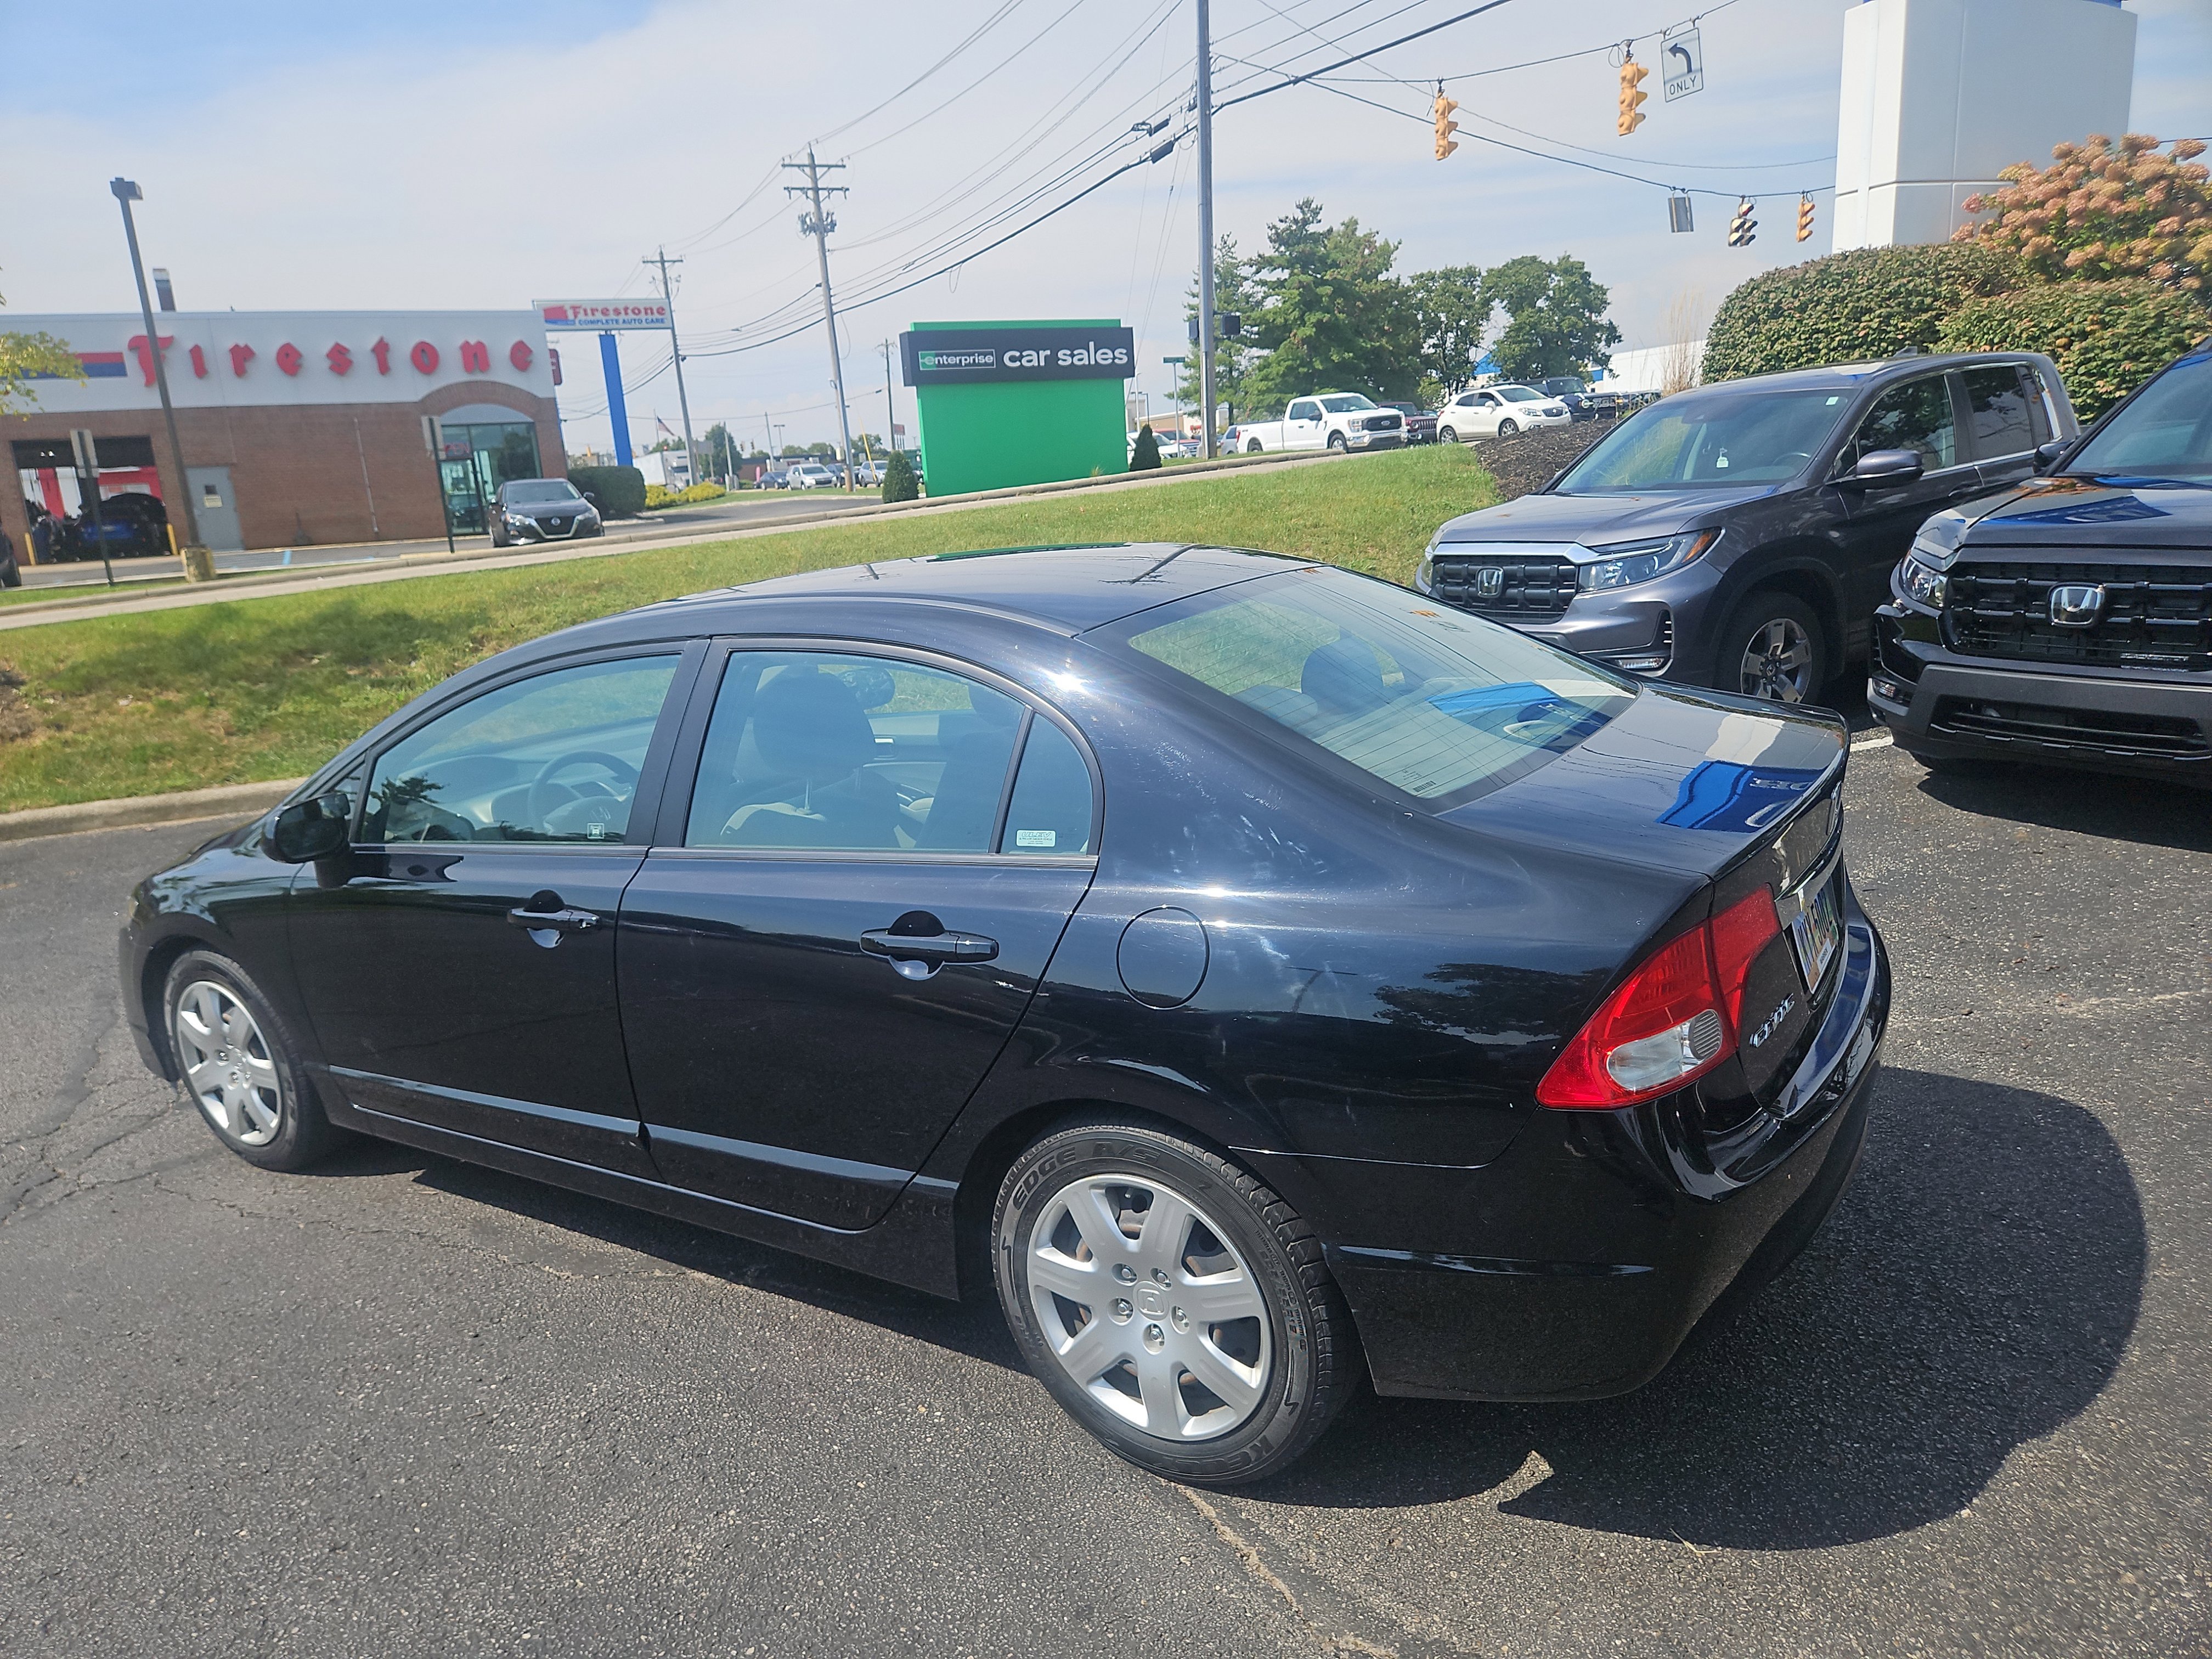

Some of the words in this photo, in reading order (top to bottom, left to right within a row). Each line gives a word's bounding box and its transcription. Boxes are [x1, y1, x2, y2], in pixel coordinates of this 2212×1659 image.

[1669, 75, 1697, 95] ONLY
[570, 305, 666, 319] Firestone
[128, 335, 533, 387] Firestone
[924, 353, 994, 366] enterprise
[1003, 349, 1051, 367] car
[1057, 341, 1128, 365] sales
[1013, 1146, 1076, 1210] EDGE
